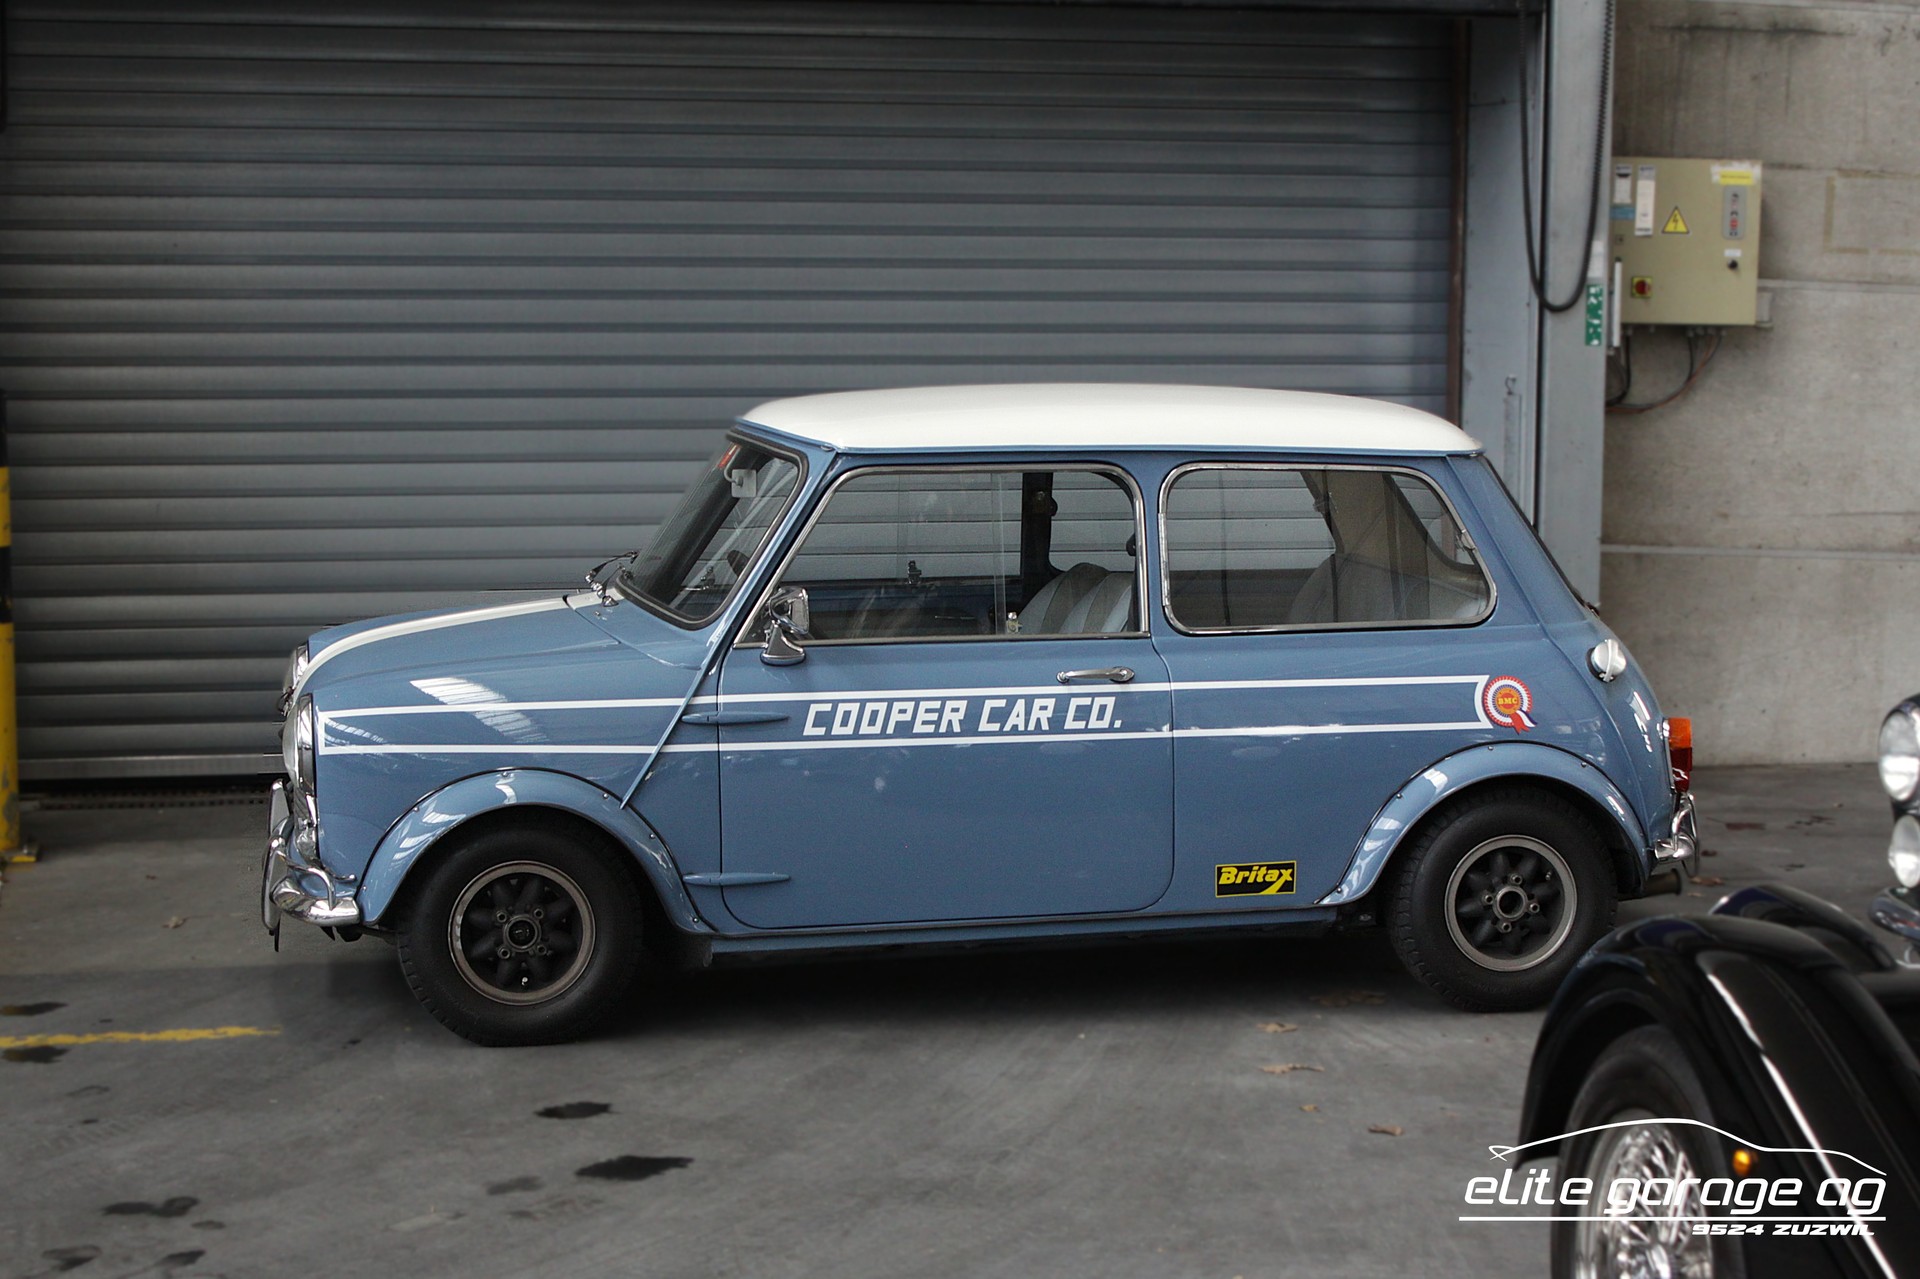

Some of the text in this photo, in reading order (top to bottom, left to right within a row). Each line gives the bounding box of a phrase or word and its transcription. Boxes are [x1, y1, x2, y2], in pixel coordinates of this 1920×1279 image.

[1498, 697, 1518, 705] BMC
[803, 697, 1123, 736] COOPER CAR CO.
[1218, 865, 1293, 887] Britax
